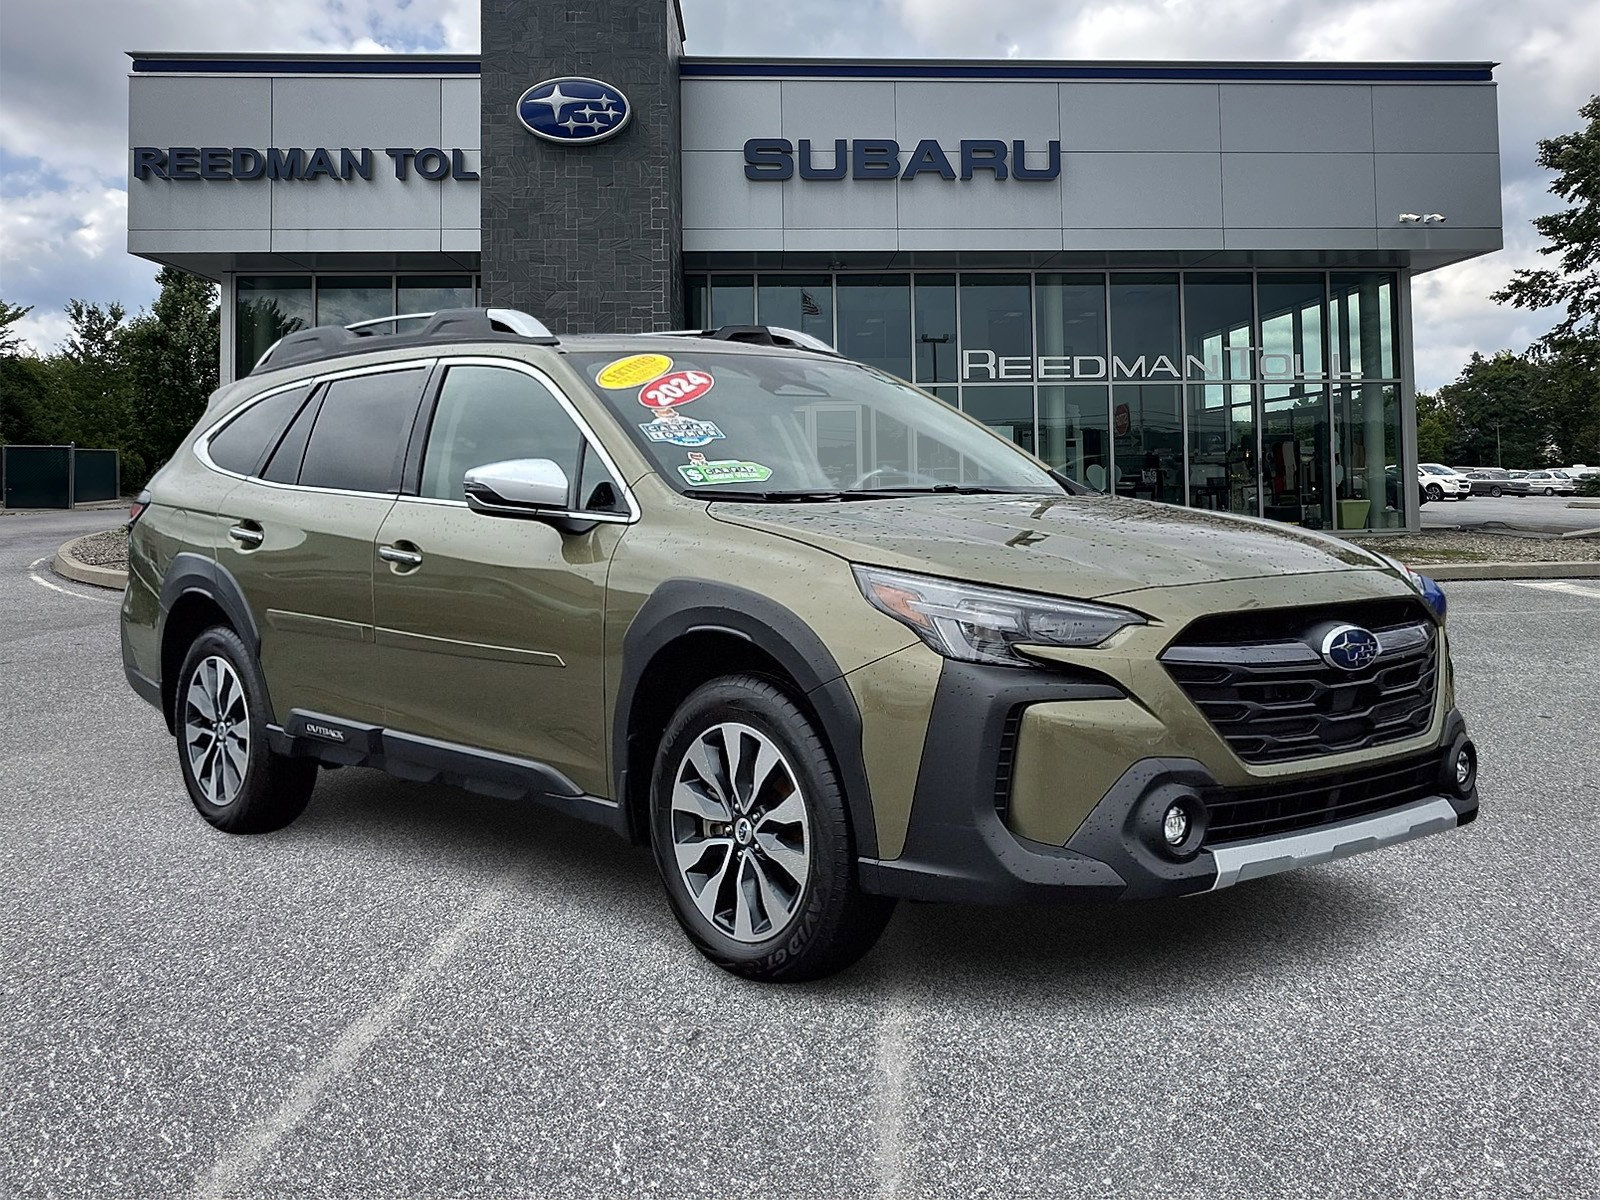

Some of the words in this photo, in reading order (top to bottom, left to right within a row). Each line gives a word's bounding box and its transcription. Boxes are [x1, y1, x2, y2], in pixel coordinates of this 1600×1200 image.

[134, 147, 372, 181] REEDMAN
[744, 138, 1061, 181] SUBARU
[647, 372, 709, 405] 2024
[306, 723, 344, 739] OUTBACK
